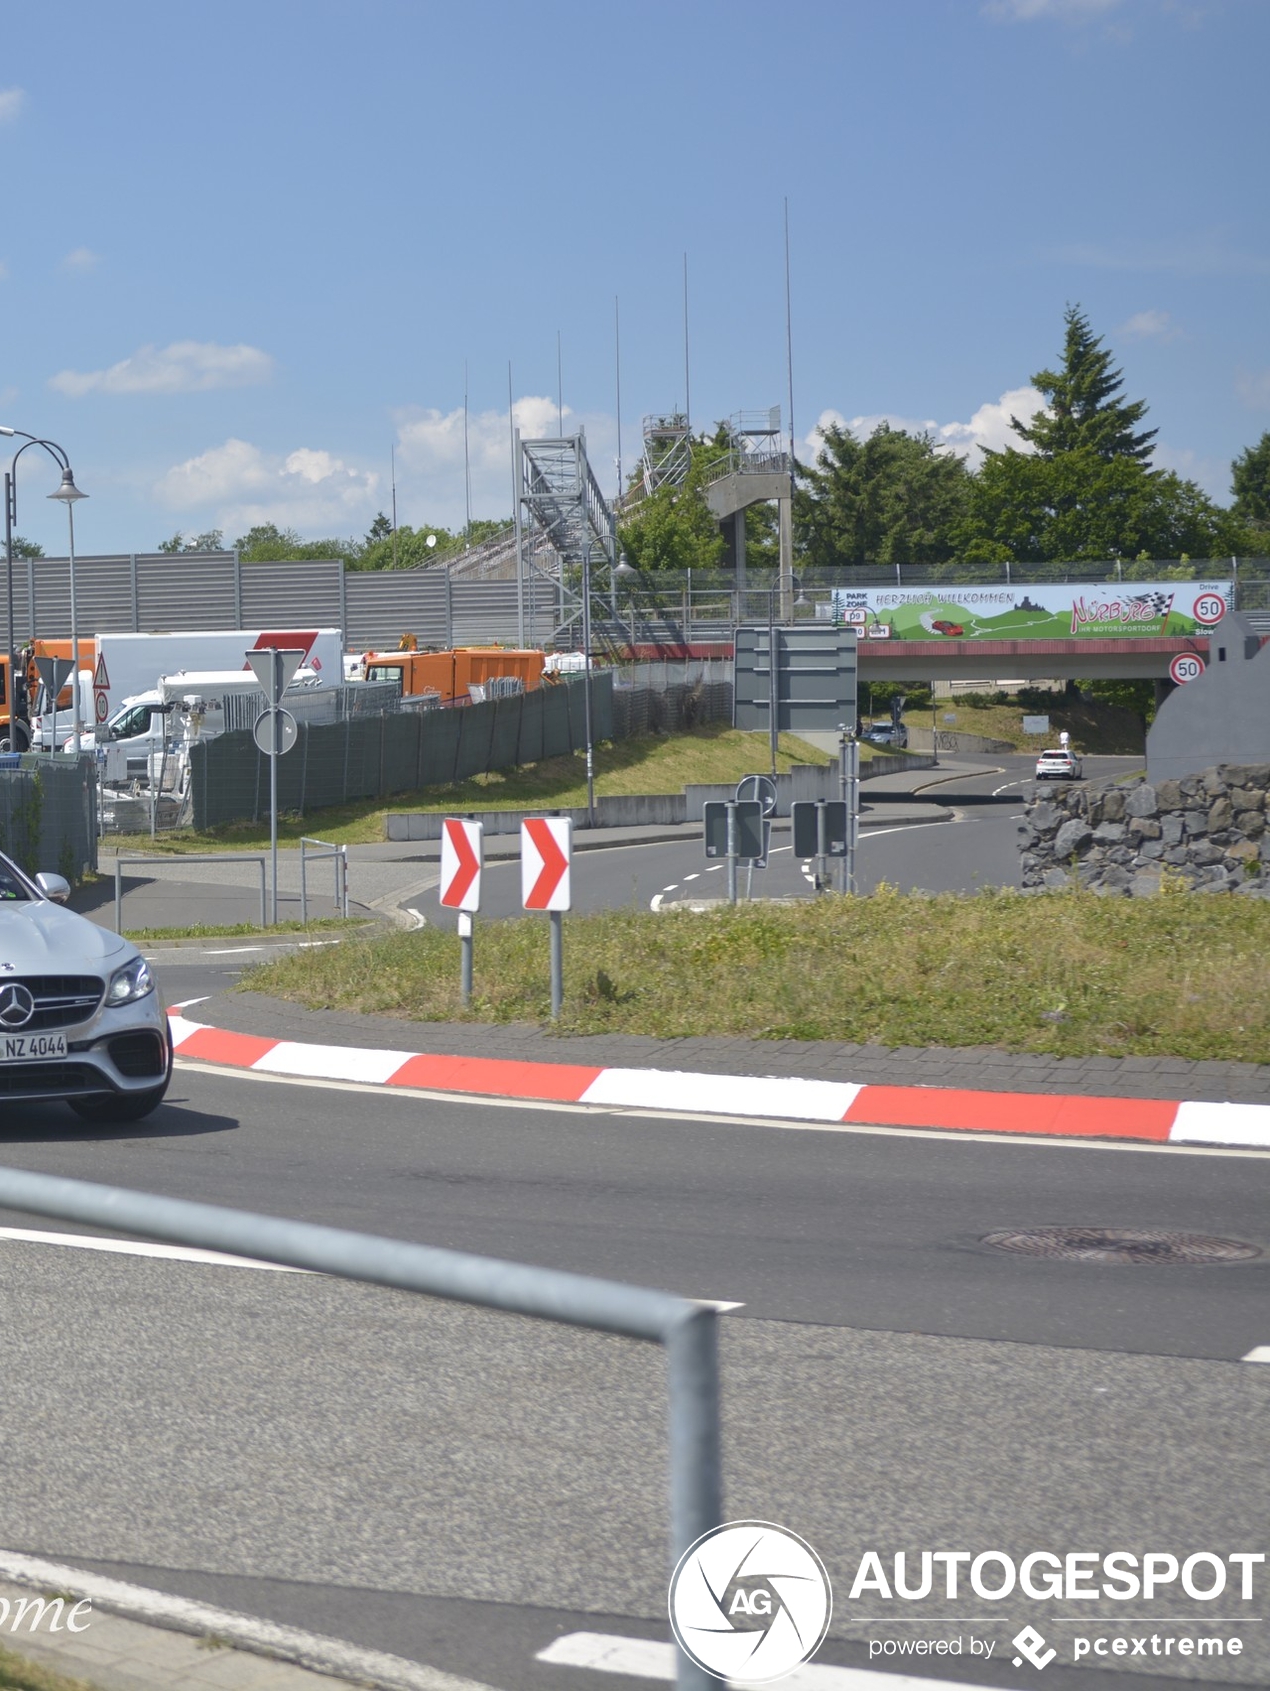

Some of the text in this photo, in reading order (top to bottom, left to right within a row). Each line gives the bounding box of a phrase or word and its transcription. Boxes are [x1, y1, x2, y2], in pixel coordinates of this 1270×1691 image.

[876, 592, 1015, 606] HERZLICH WILLKOMMEN
[1070, 595, 1156, 635] NÜRBURG
[1200, 601, 1219, 616] 50
[1195, 628, 1214, 636] Slow
[1179, 662, 1197, 676] 50
[5, 1039, 26, 1057] NZ
[29, 1036, 65, 1056] 4044
